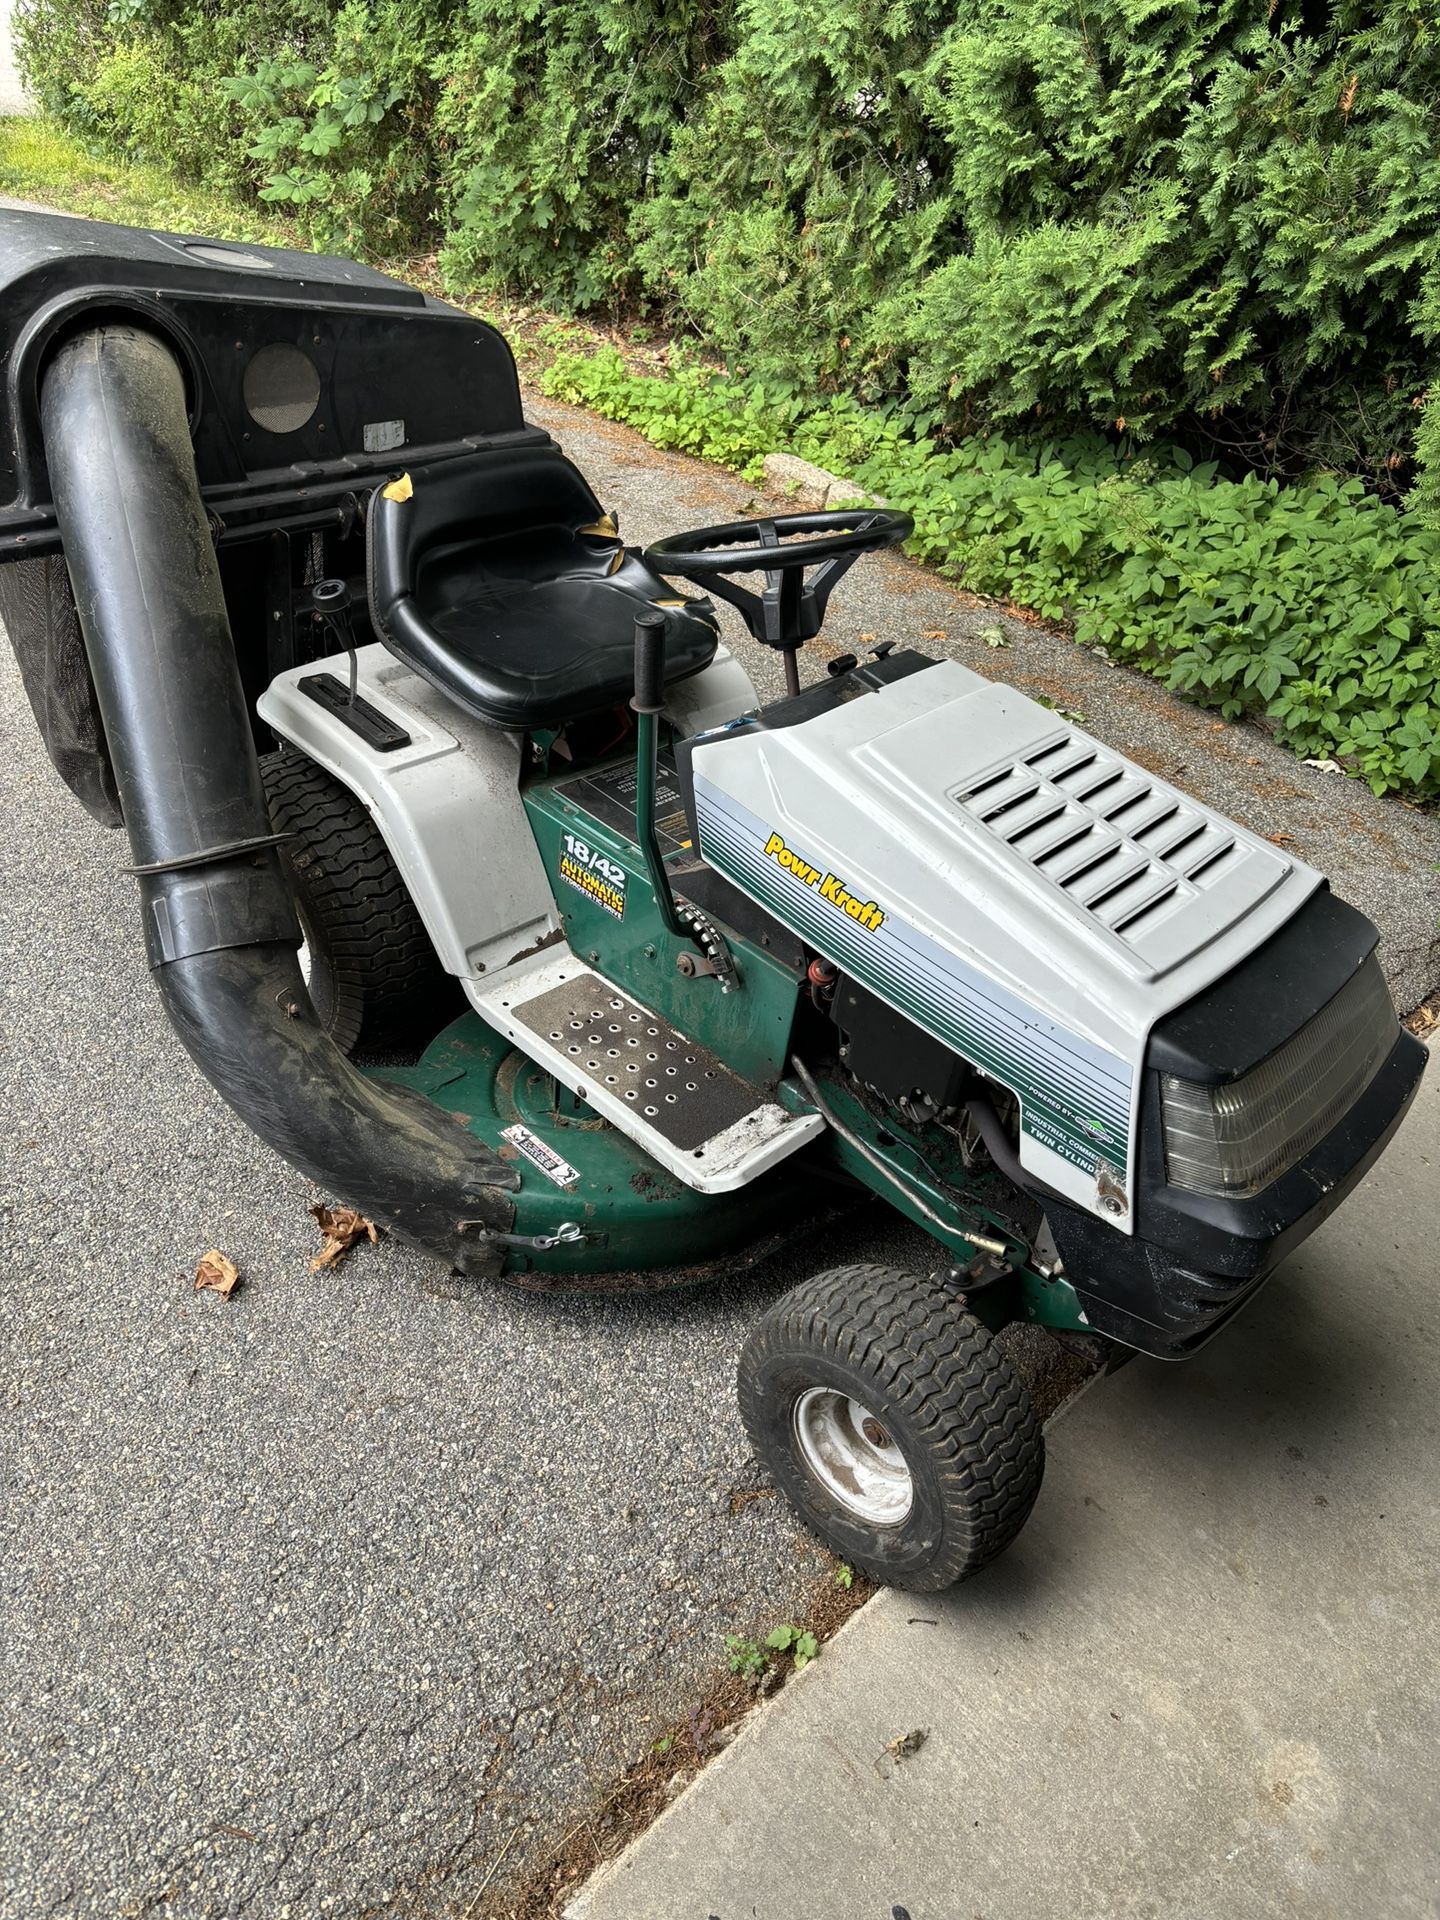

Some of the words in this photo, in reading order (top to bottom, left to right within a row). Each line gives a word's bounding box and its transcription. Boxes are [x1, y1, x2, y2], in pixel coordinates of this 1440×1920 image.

[561, 857, 624, 906] AUTOMATIC
[564, 834, 626, 889] 18/42
[764, 831, 823, 887] Powr
[818, 871, 885, 932] Kraft
[560, 866, 623, 913] TRANSMISSION
[1028, 1085, 1062, 1110] POWERED
[1025, 1110, 1068, 1142] INDUSTRIAL
[1030, 1125, 1056, 1147] TWIN
